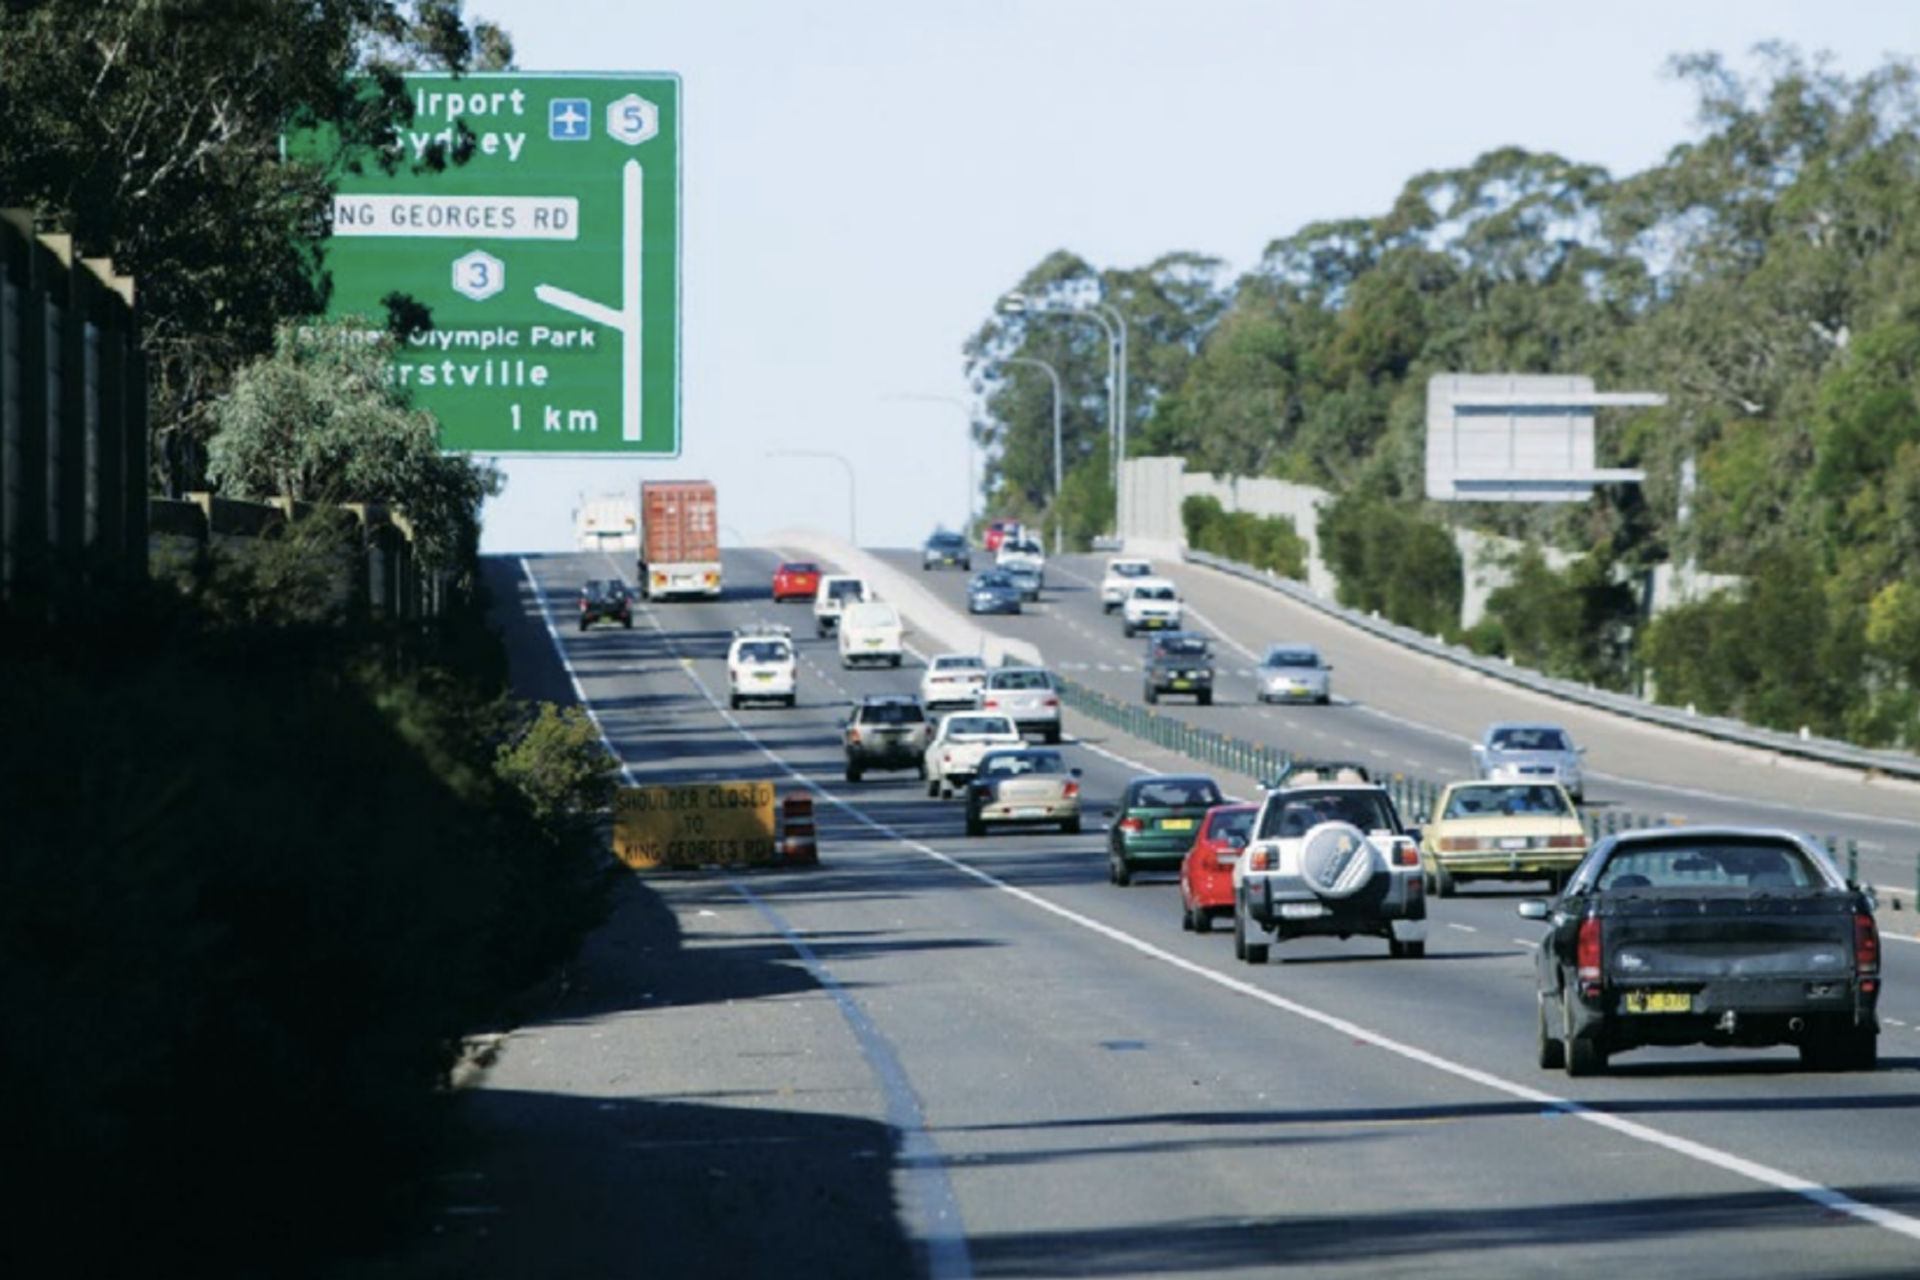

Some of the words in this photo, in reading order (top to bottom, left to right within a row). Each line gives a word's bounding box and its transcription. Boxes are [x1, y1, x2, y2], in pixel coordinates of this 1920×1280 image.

[417, 88, 526, 121] irport
[623, 107, 643, 132] 5
[391, 204, 516, 228] GEORGES
[534, 207, 568, 229] RD
[468, 263, 488, 288] 3
[531, 326, 595, 347] Park
[510, 404, 520, 431] 1
[544, 405, 598, 431] km
[616, 788, 699, 811] SHOULDER
[707, 787, 771, 809] CLOSED
[683, 814, 704, 834] TO
[624, 842, 661, 861] KING
[667, 840, 738, 861] GEORGES
[744, 839, 766, 858] RD
